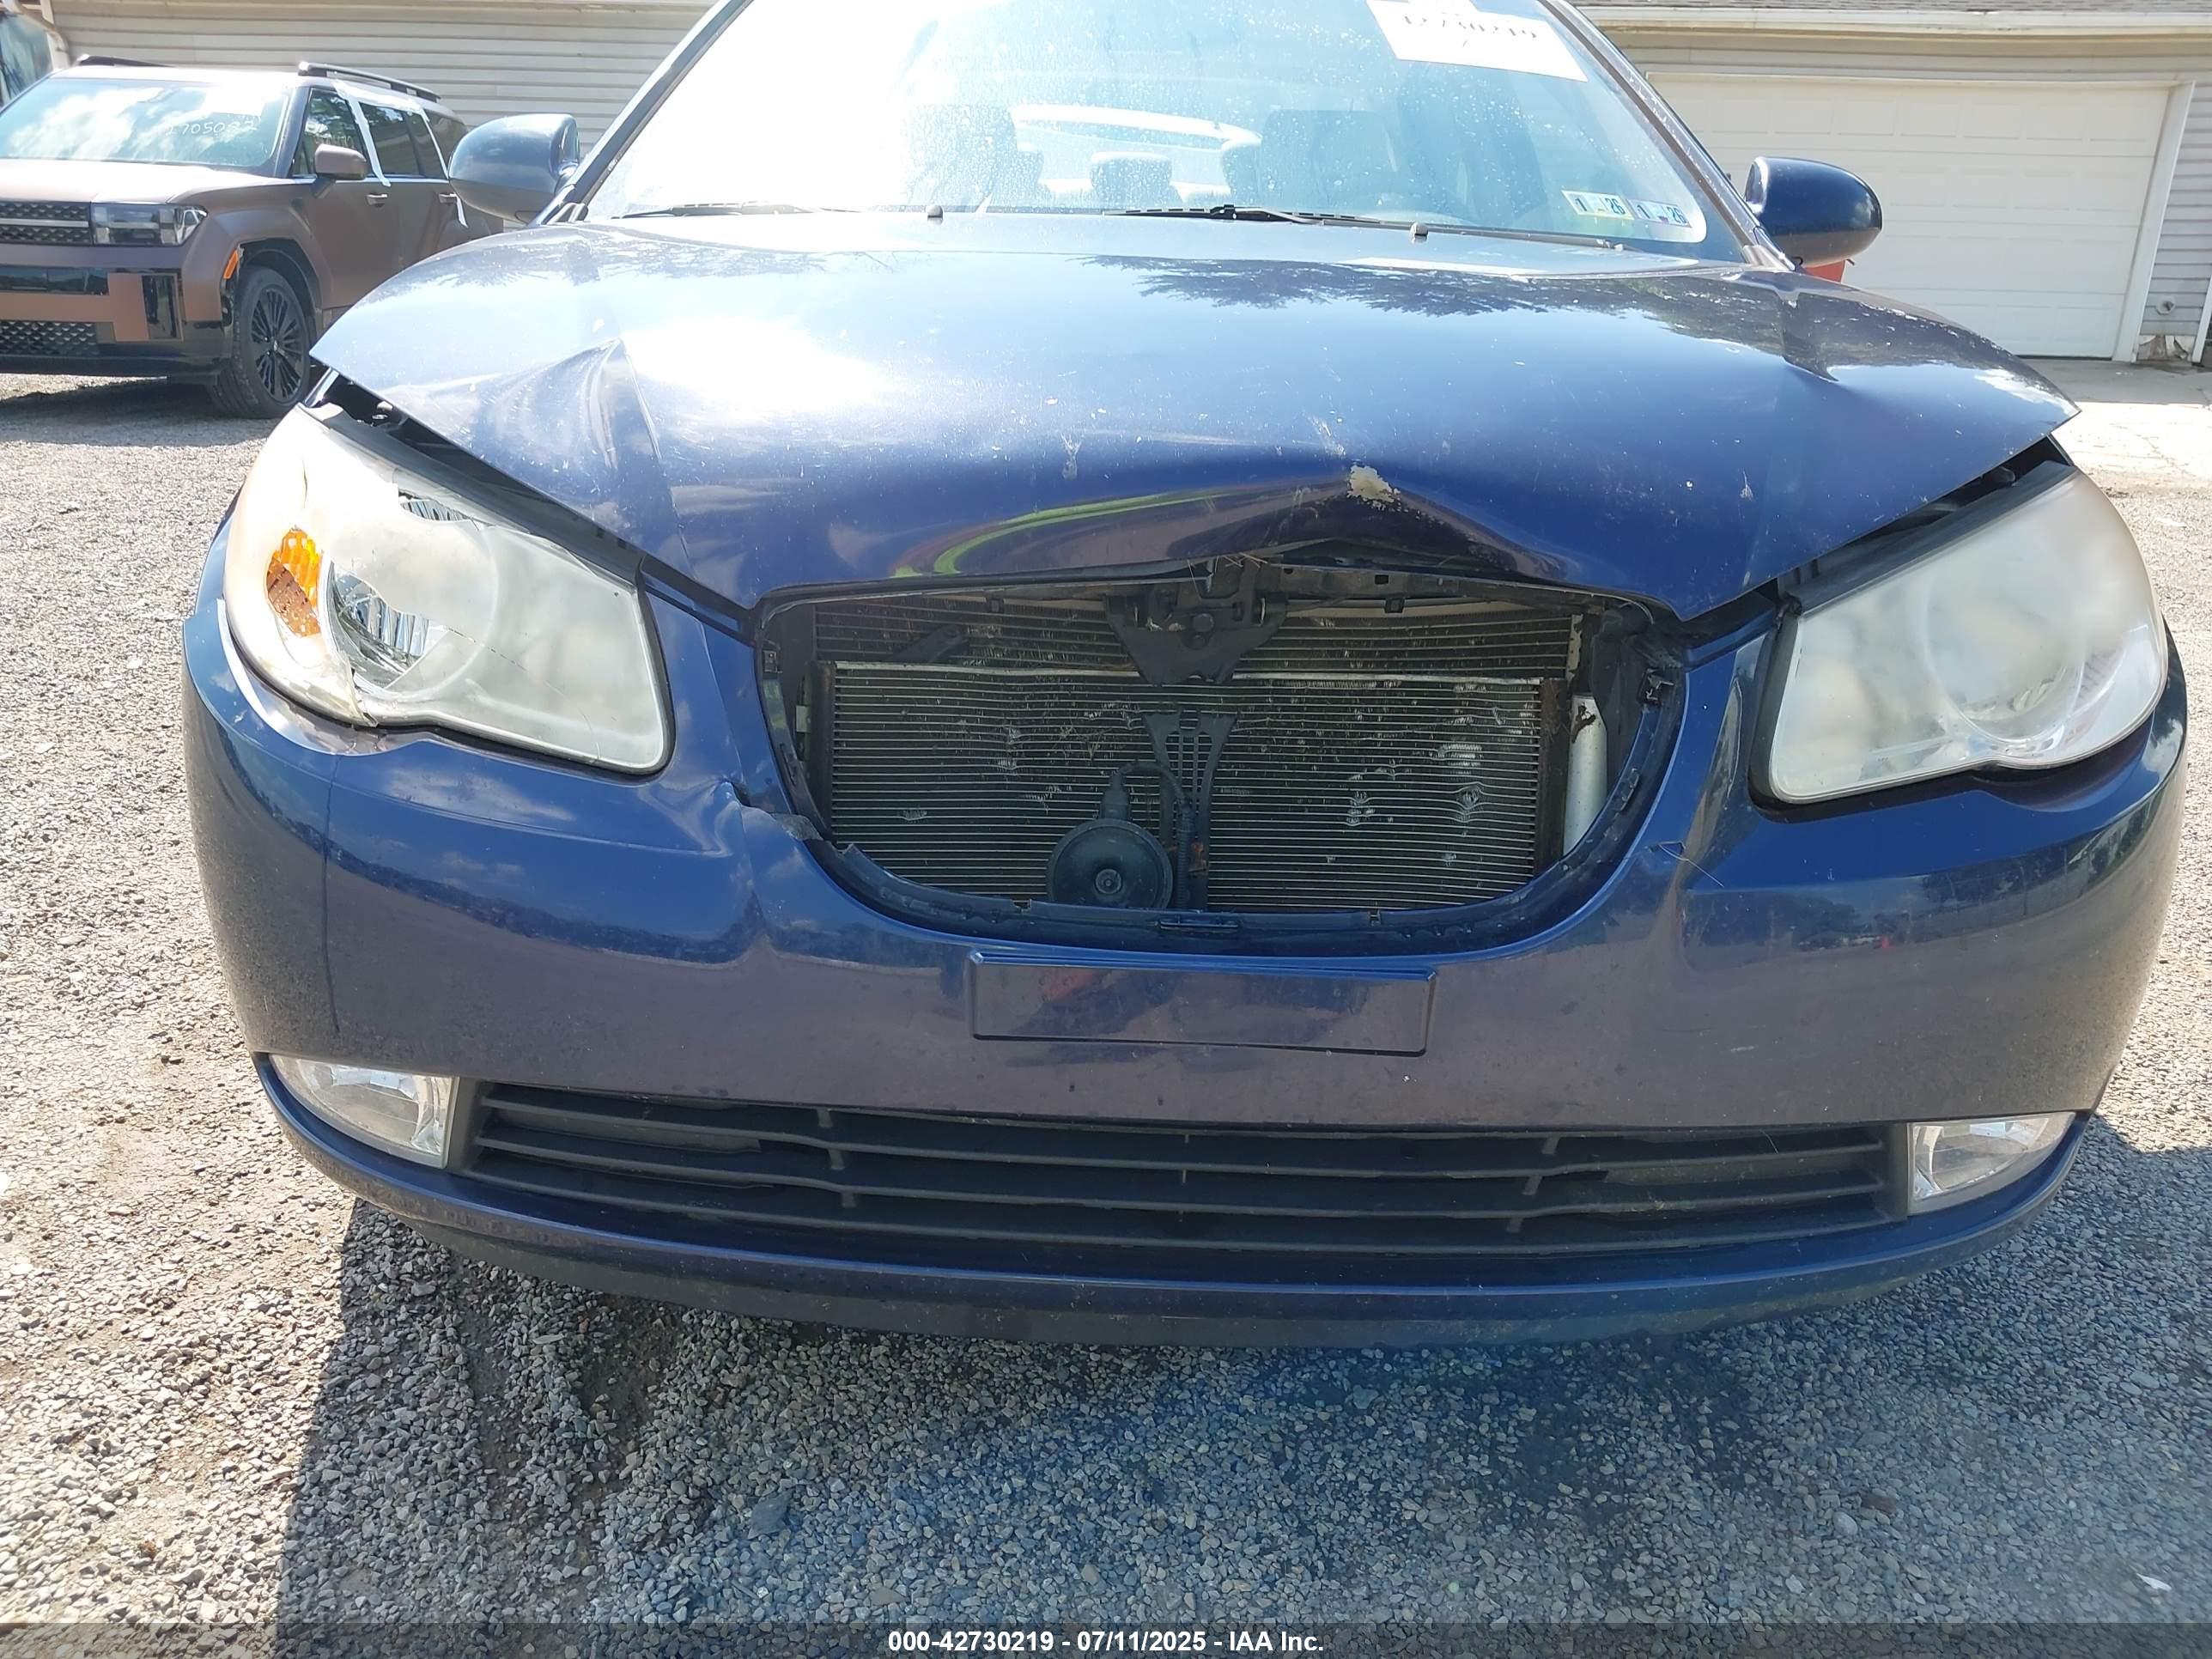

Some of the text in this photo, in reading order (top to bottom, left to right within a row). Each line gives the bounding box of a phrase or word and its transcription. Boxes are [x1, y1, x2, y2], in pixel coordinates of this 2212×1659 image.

[1575, 198, 1626, 216] 1 26
[1637, 204, 1687, 224] 1 26
